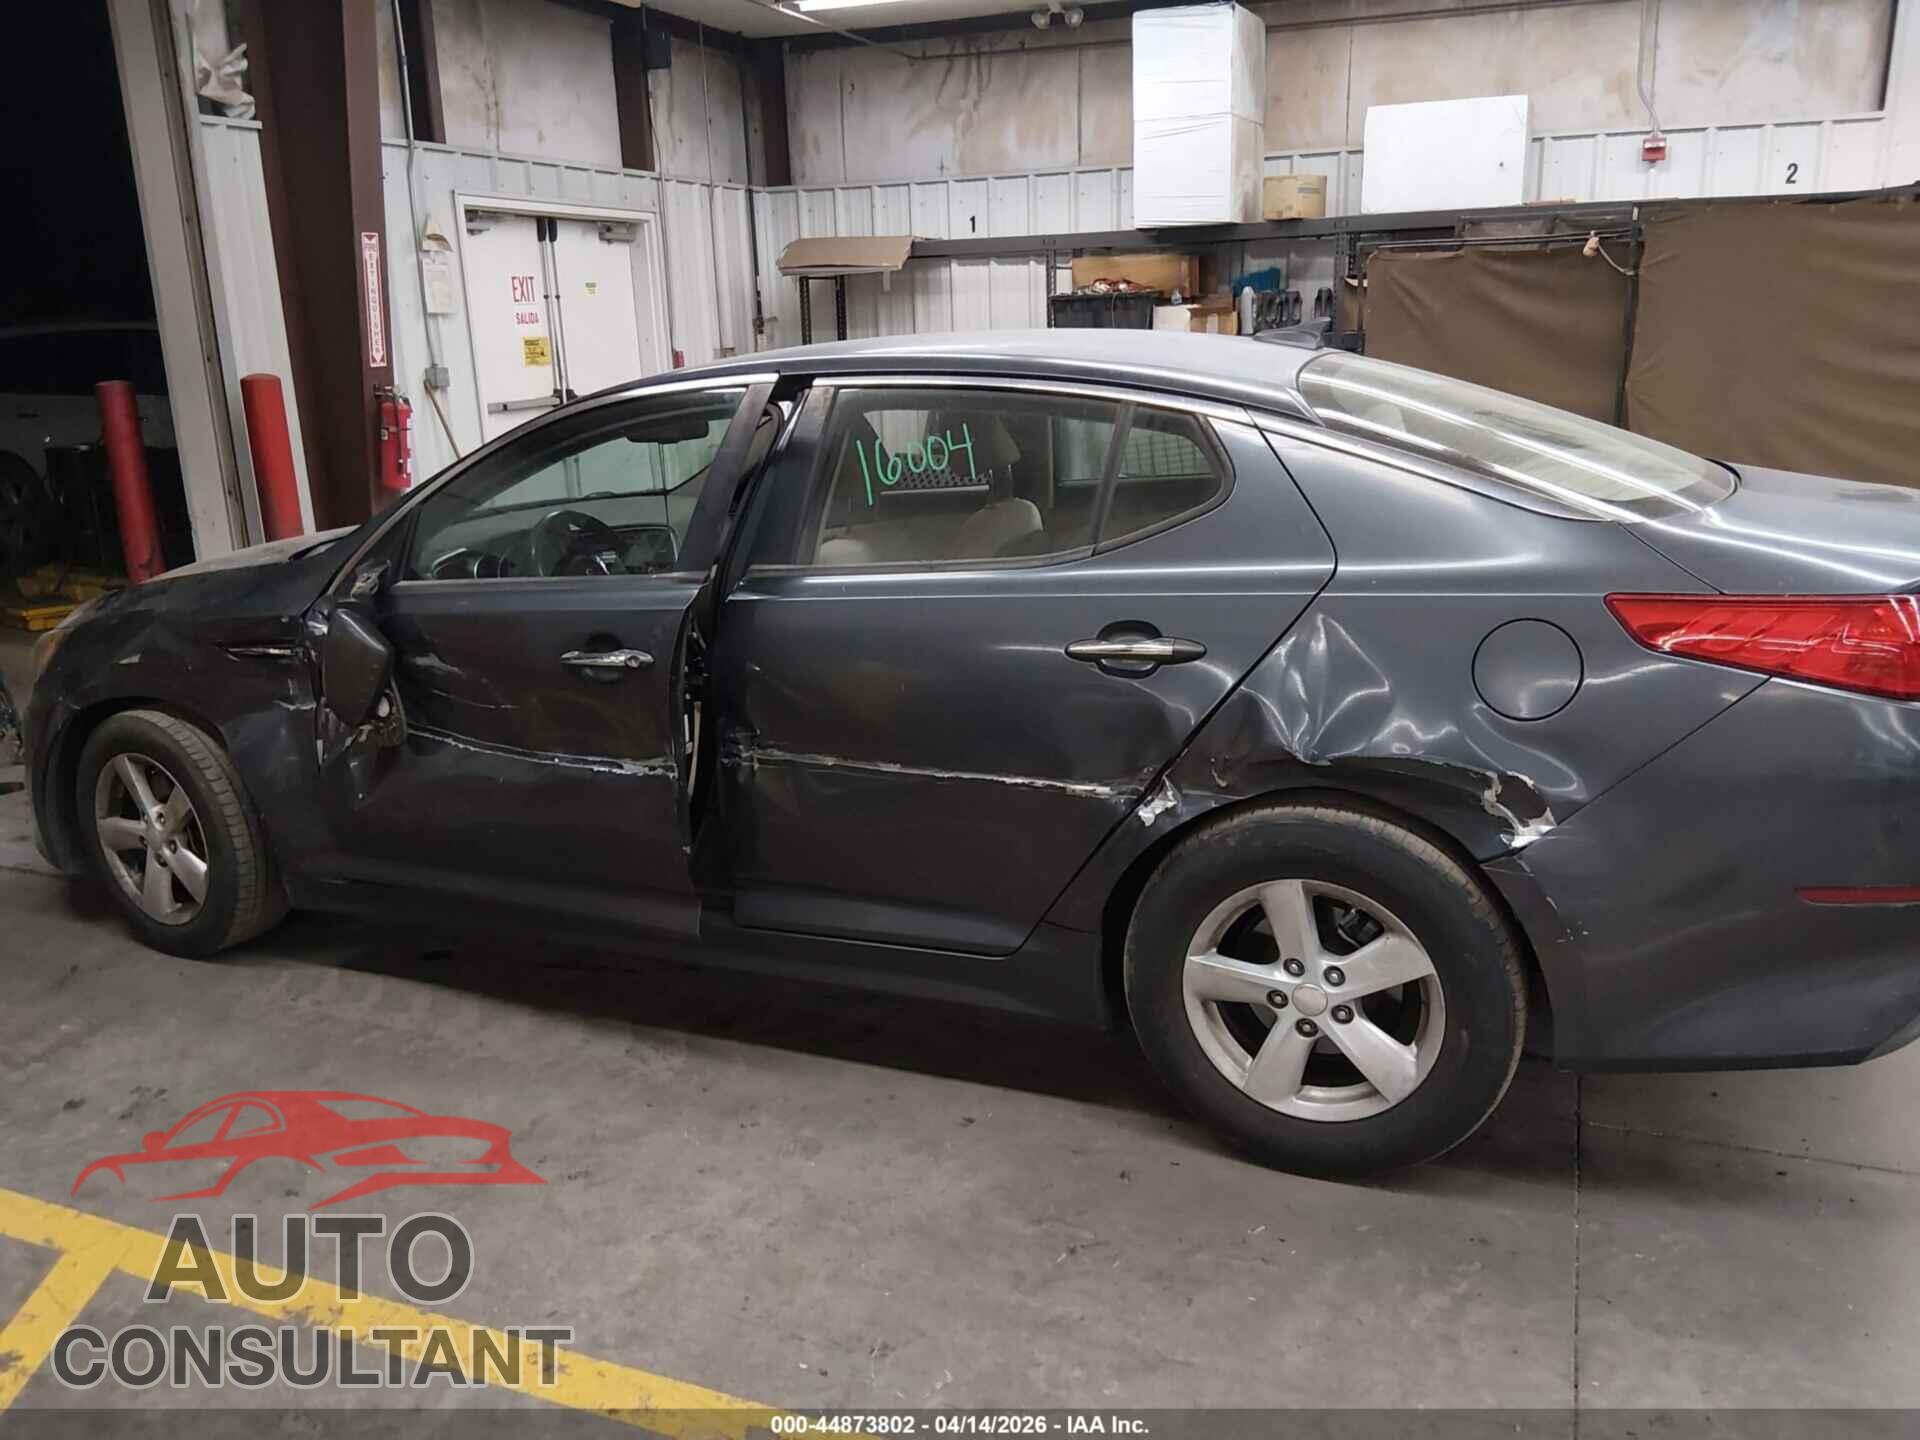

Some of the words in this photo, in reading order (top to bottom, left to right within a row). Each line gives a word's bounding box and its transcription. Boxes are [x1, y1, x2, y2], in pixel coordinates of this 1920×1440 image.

[1785, 162, 1799, 185] 2
[969, 215, 976, 233] 1
[511, 276, 536, 303] EXIT
[515, 311, 540, 325] SALIDA
[855, 422, 977, 507] 16004
